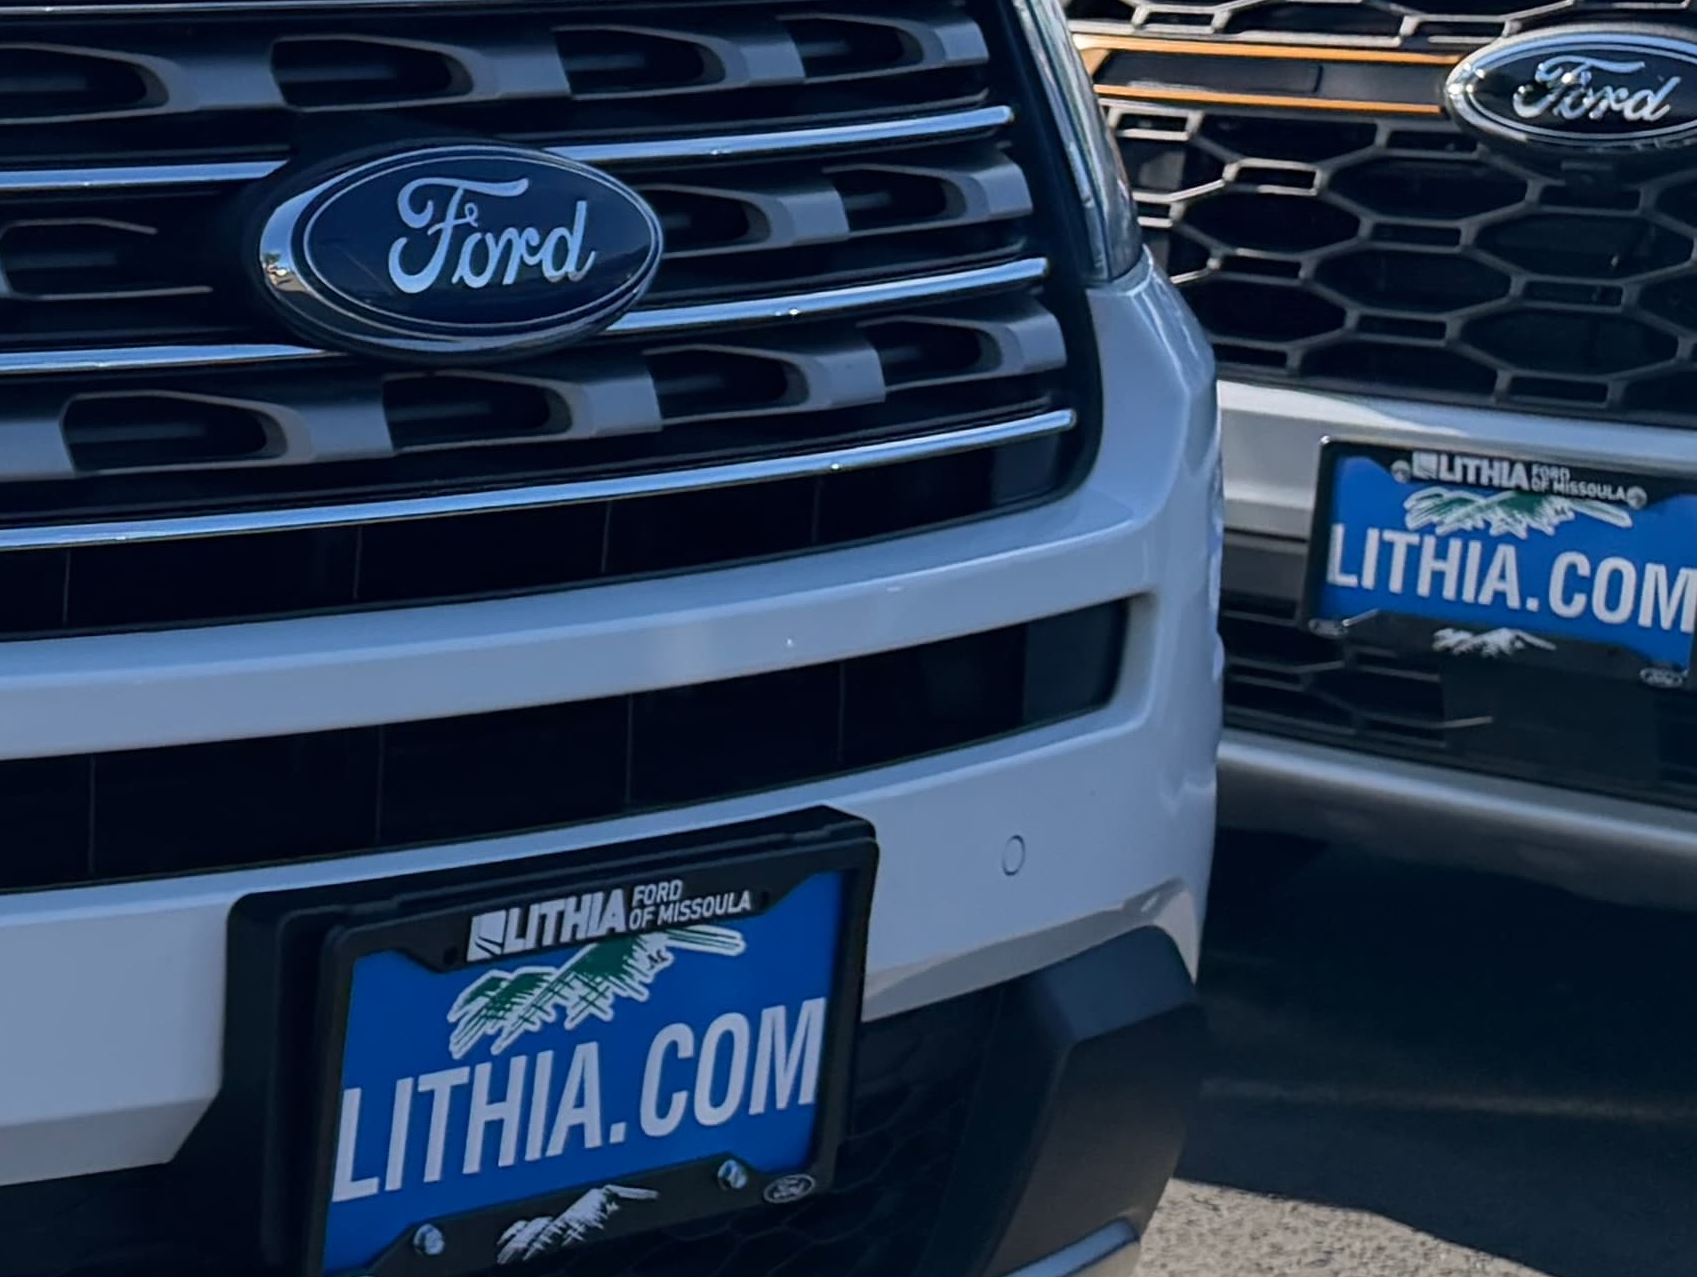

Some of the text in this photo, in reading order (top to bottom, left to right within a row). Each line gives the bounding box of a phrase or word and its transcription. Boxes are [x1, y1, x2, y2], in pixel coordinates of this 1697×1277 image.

[1512, 54, 1683, 123] Ford
[387, 176, 597, 294] Ford
[1438, 453, 1530, 490] LITHIA
[1326, 523, 1696, 634] LITHIA.COM
[501, 887, 628, 955] LITHIA
[628, 889, 753, 931] OF MISSOULA
[631, 878, 684, 909] FORD
[330, 995, 827, 1204] LITHIA.COM
